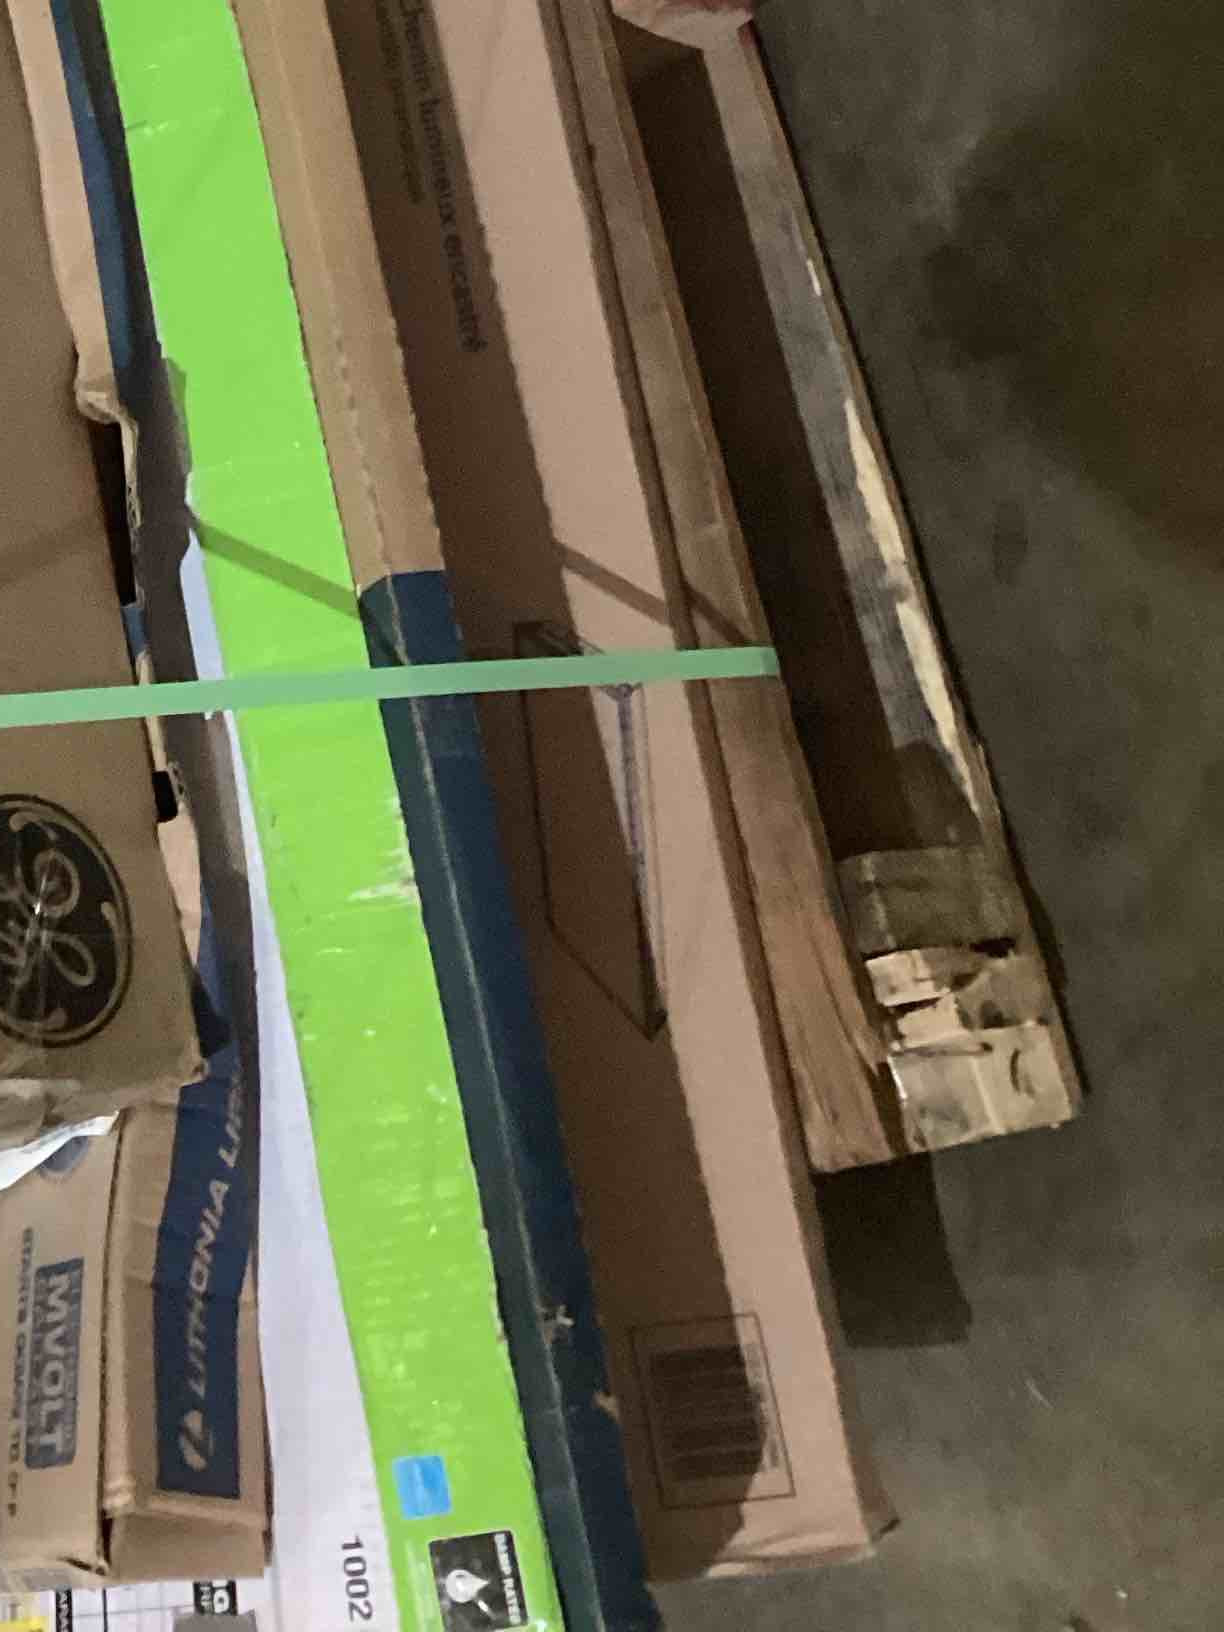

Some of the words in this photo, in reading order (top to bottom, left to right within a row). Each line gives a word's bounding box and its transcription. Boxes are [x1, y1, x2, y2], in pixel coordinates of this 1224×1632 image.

[39, 1274, 70, 1453] MVOLT
[187, 1179, 230, 1397] LITHONIA
[339, 1537, 372, 1623] 1002
